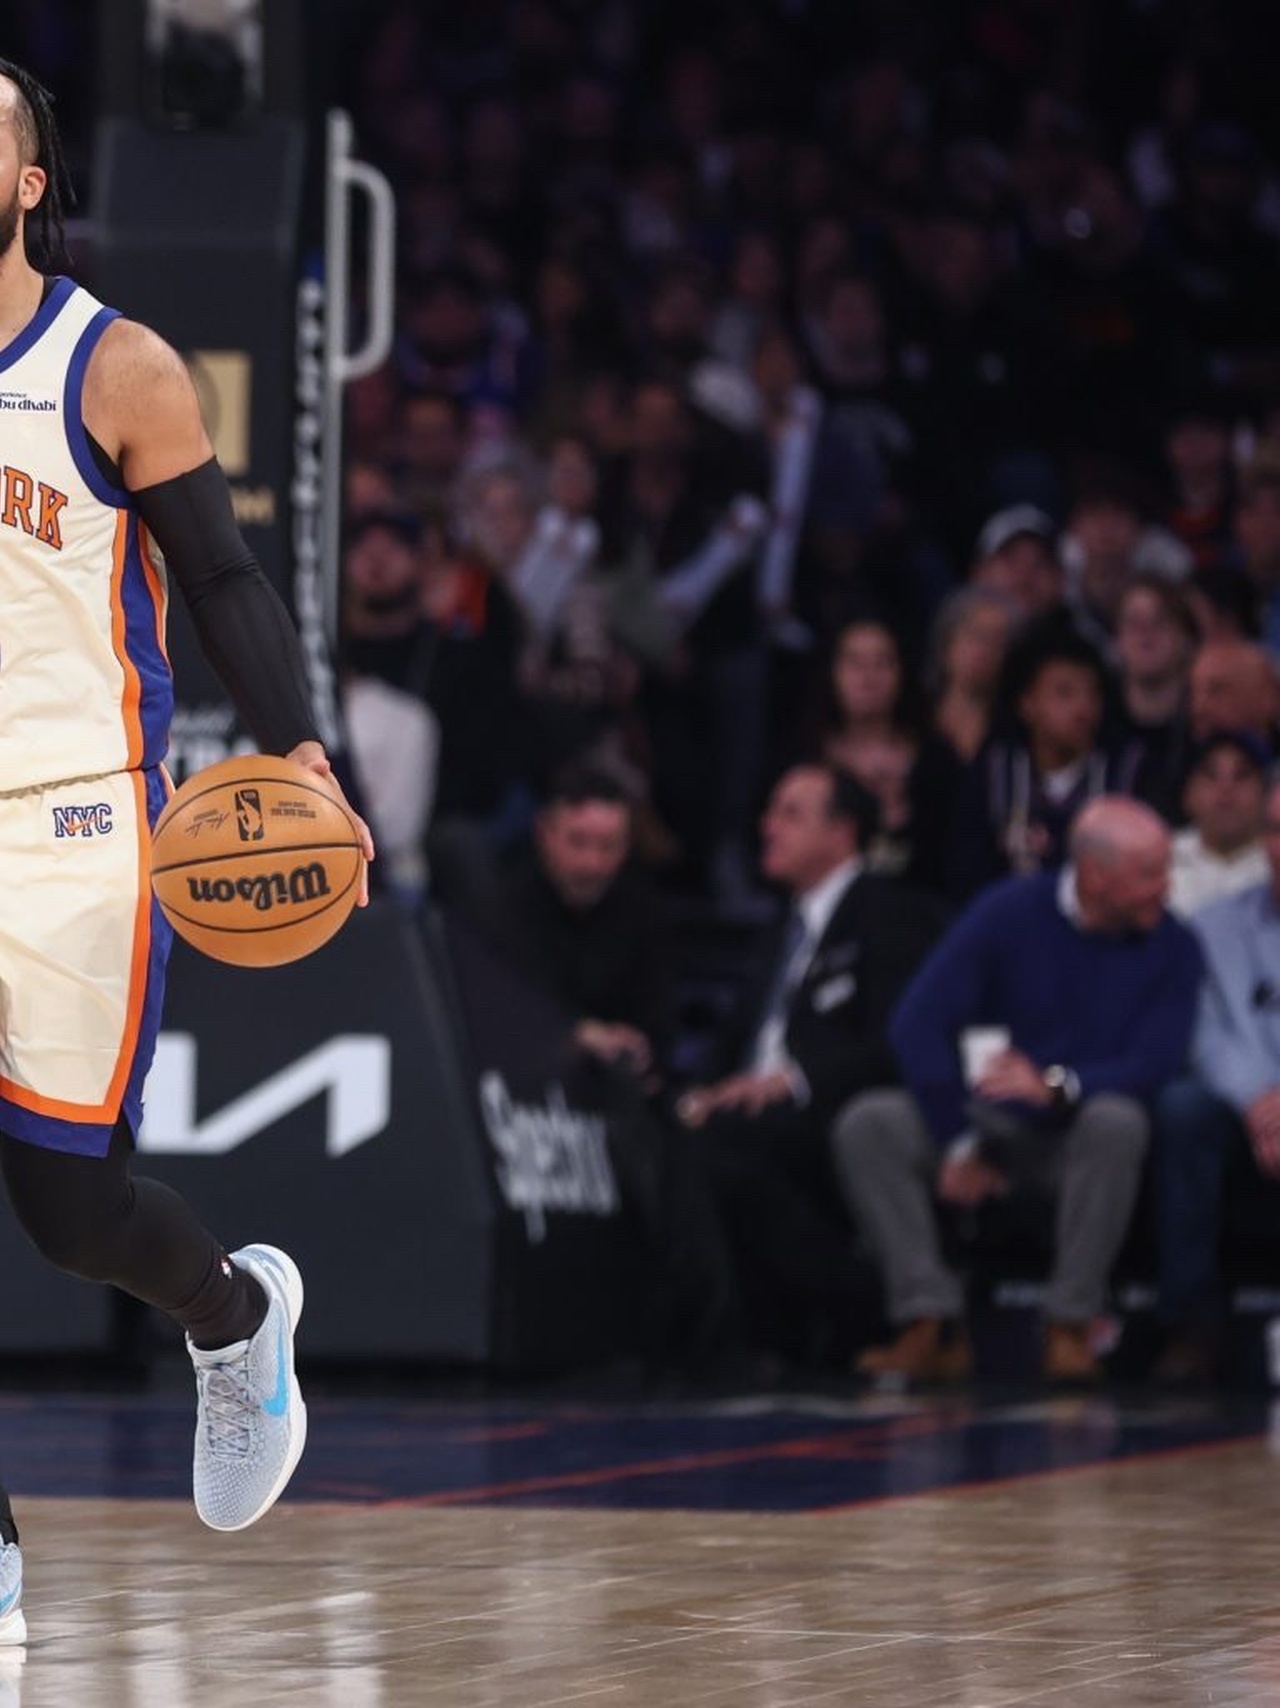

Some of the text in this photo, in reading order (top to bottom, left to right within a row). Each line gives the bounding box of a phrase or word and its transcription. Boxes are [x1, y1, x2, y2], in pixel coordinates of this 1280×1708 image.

[17, 399, 57, 411] dhabi
[53, 803, 113, 837] NYC
[187, 861, 331, 911] Wilson
